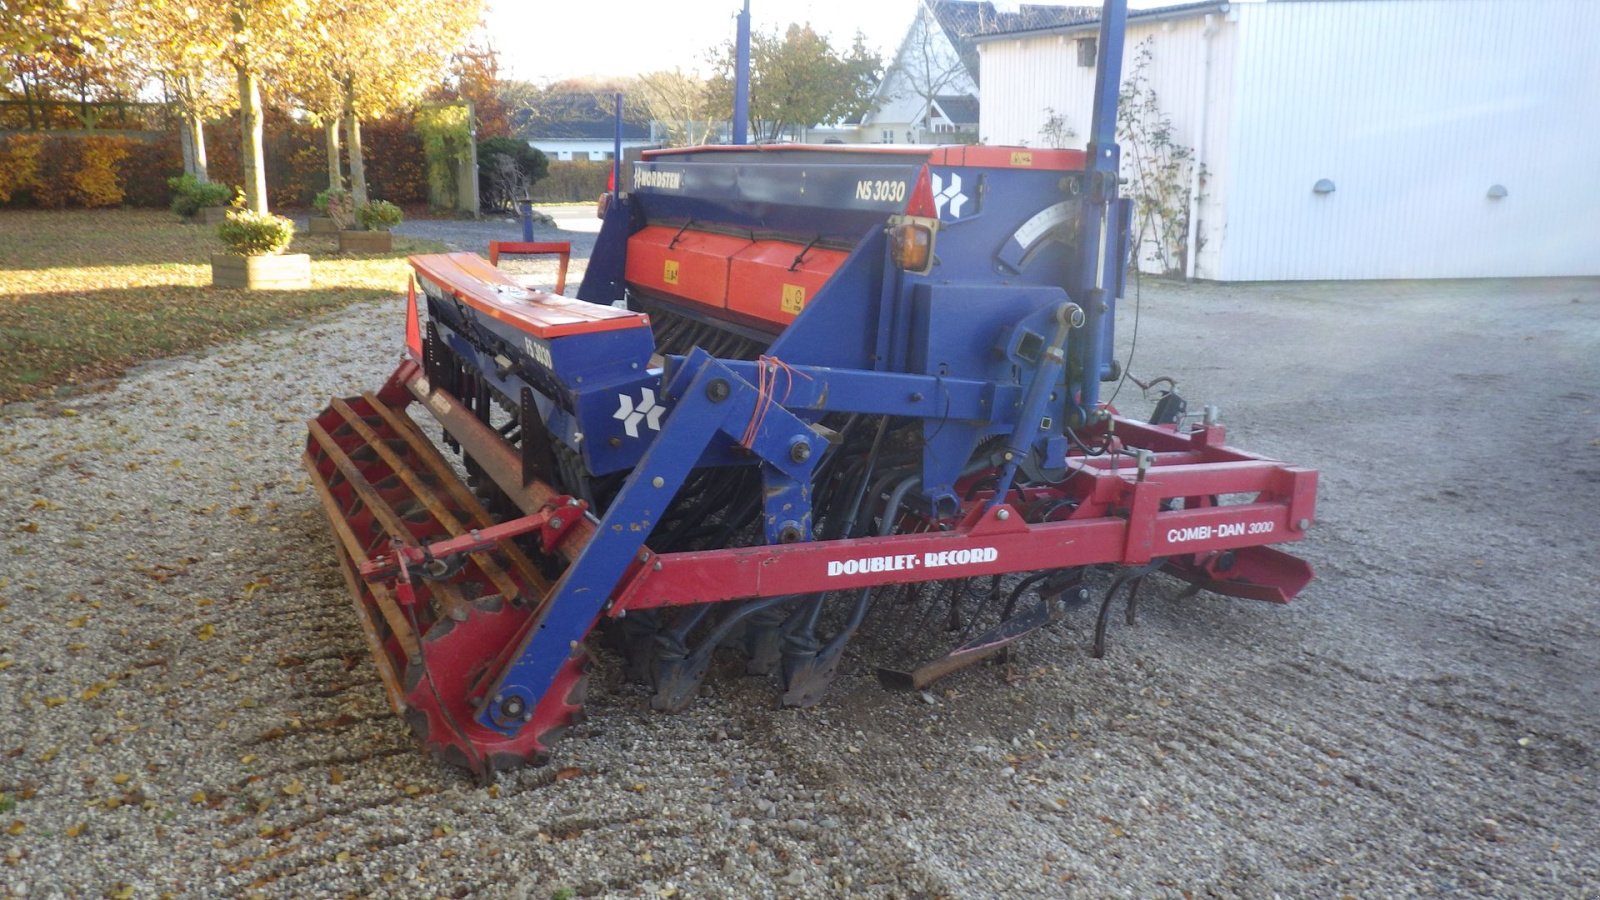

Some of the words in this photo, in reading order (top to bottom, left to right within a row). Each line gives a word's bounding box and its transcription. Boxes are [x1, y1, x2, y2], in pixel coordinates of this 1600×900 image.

[640, 170, 680, 189] NORDSTEN
[855, 180, 873, 200] NS
[872, 180, 906, 202] 3030
[1167, 523, 1245, 543] COMBI-DAN
[1247, 521, 1274, 534] 3000
[924, 547, 998, 568] RECORD
